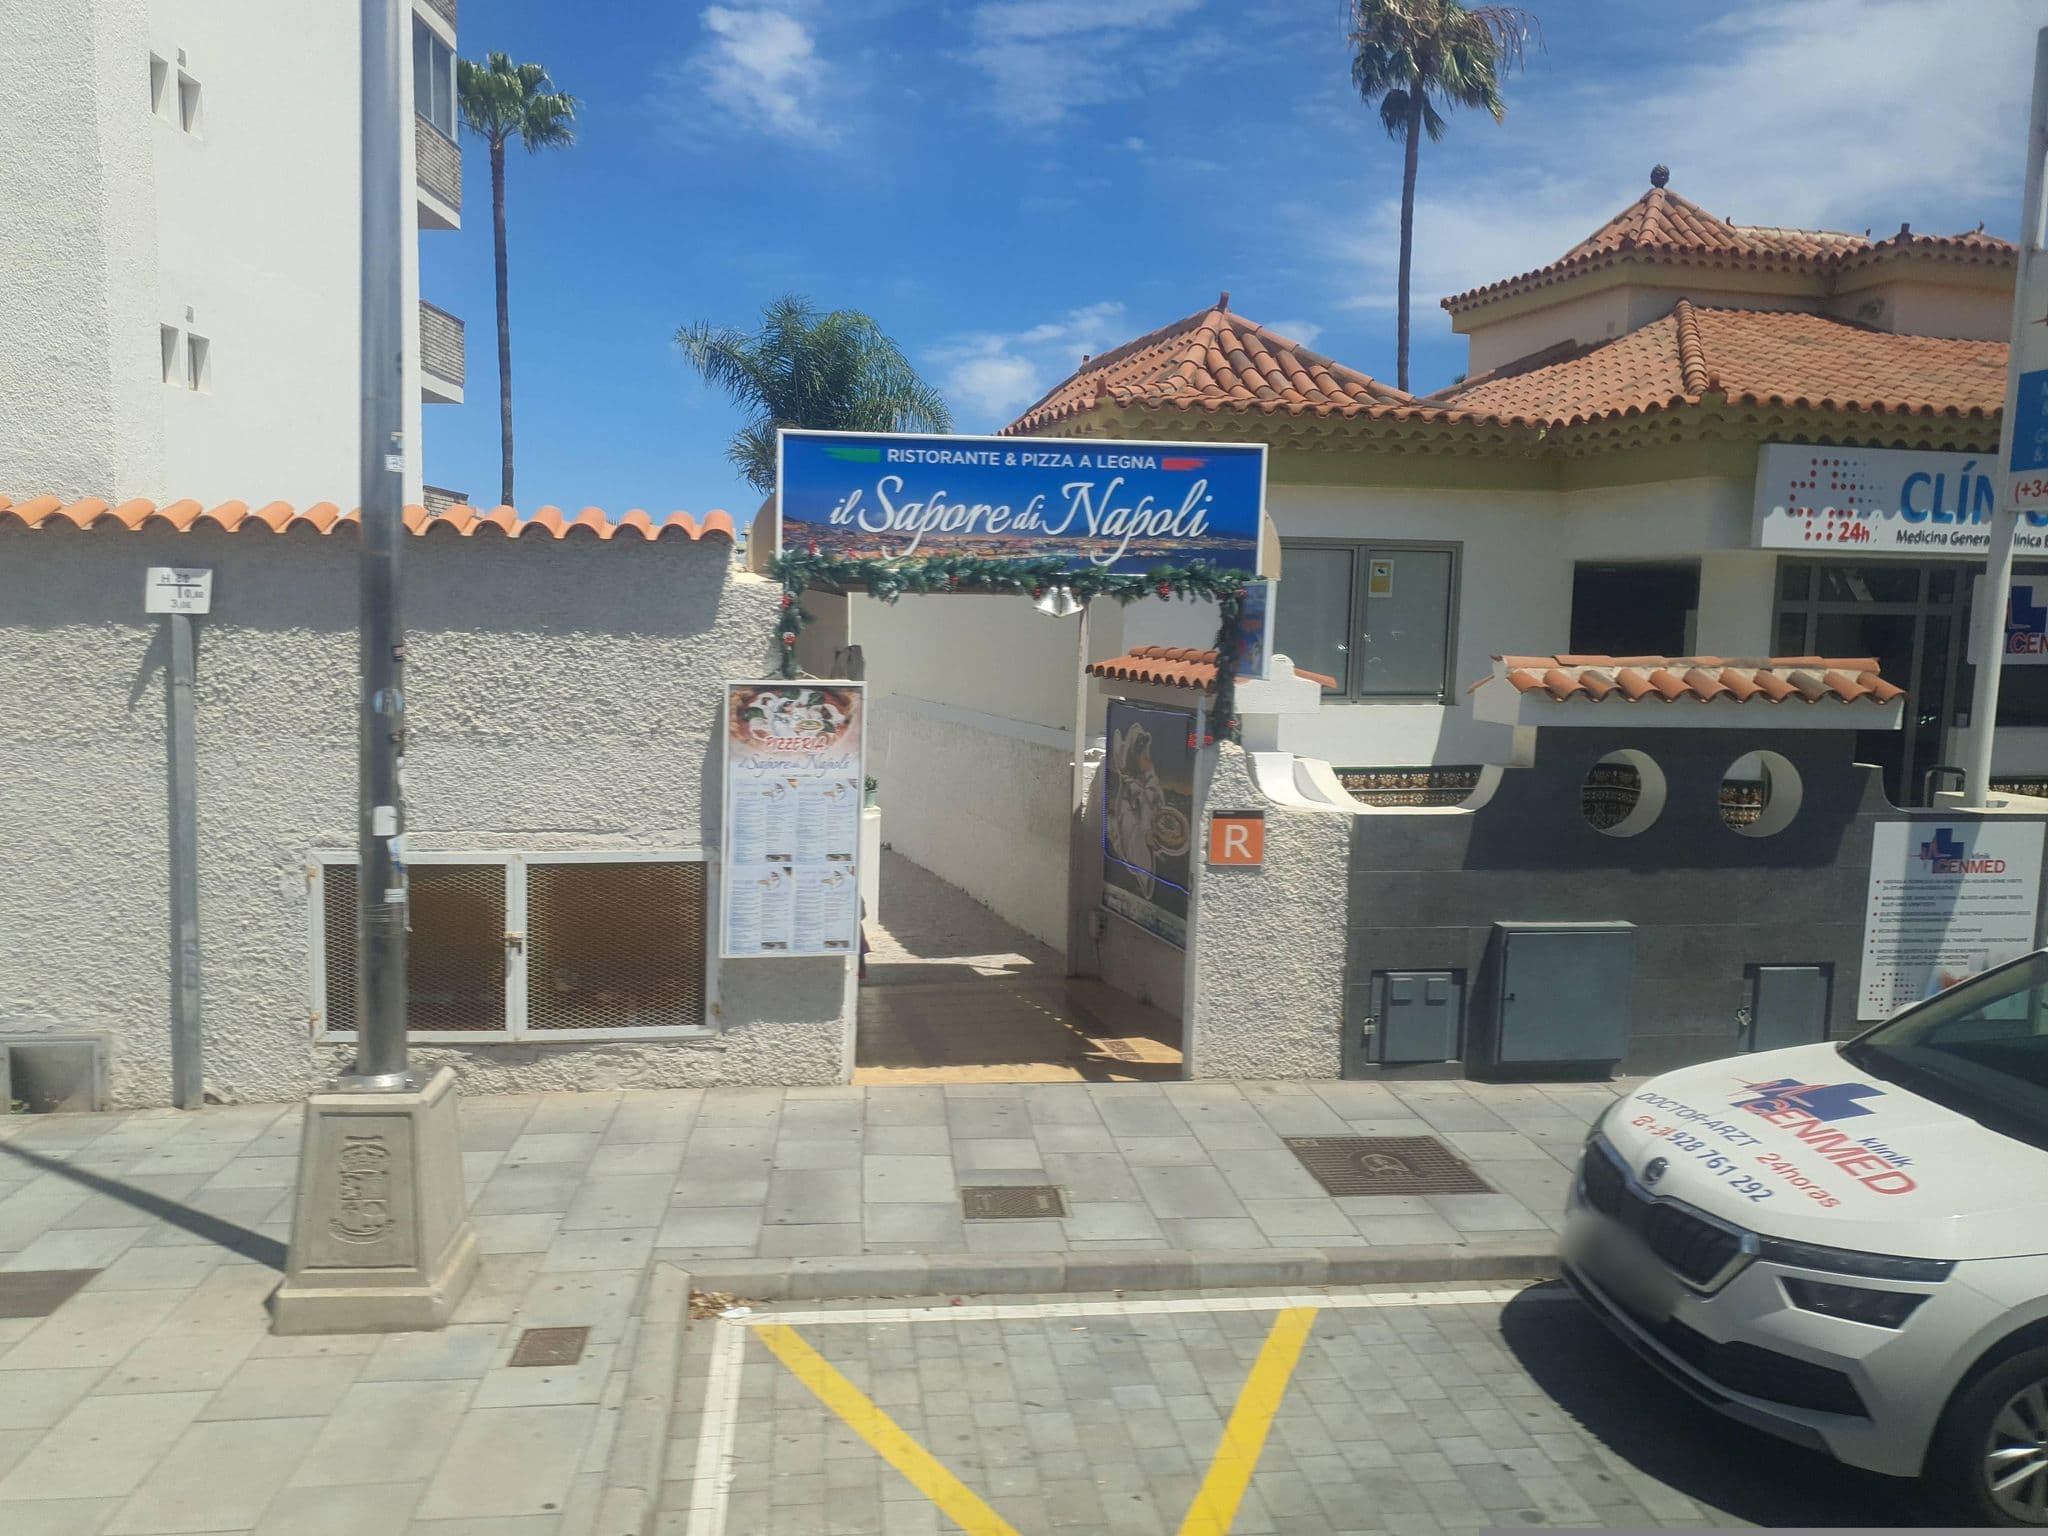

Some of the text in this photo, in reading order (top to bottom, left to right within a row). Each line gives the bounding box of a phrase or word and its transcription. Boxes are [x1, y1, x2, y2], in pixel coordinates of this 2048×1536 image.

[887, 448, 1157, 471] RISTORANTE & PIZZA A LEGNA
[830, 475, 1214, 567] il Sapore di Napoli
[1838, 521, 1871, 544] 24h
[1896, 529, 1949, 545] Medicina
[1950, 531, 1991, 547] Genera
[2013, 532, 2042, 548] línica
[1224, 824, 1253, 858] R
[1635, 1092, 1763, 1147] DOCTOR-ARZT
[1666, 1131, 1706, 1152] 928
[1696, 1149, 1739, 1177] 761
[1728, 1175, 1775, 1203] 292
[1754, 1152, 1842, 1208] 24horas
